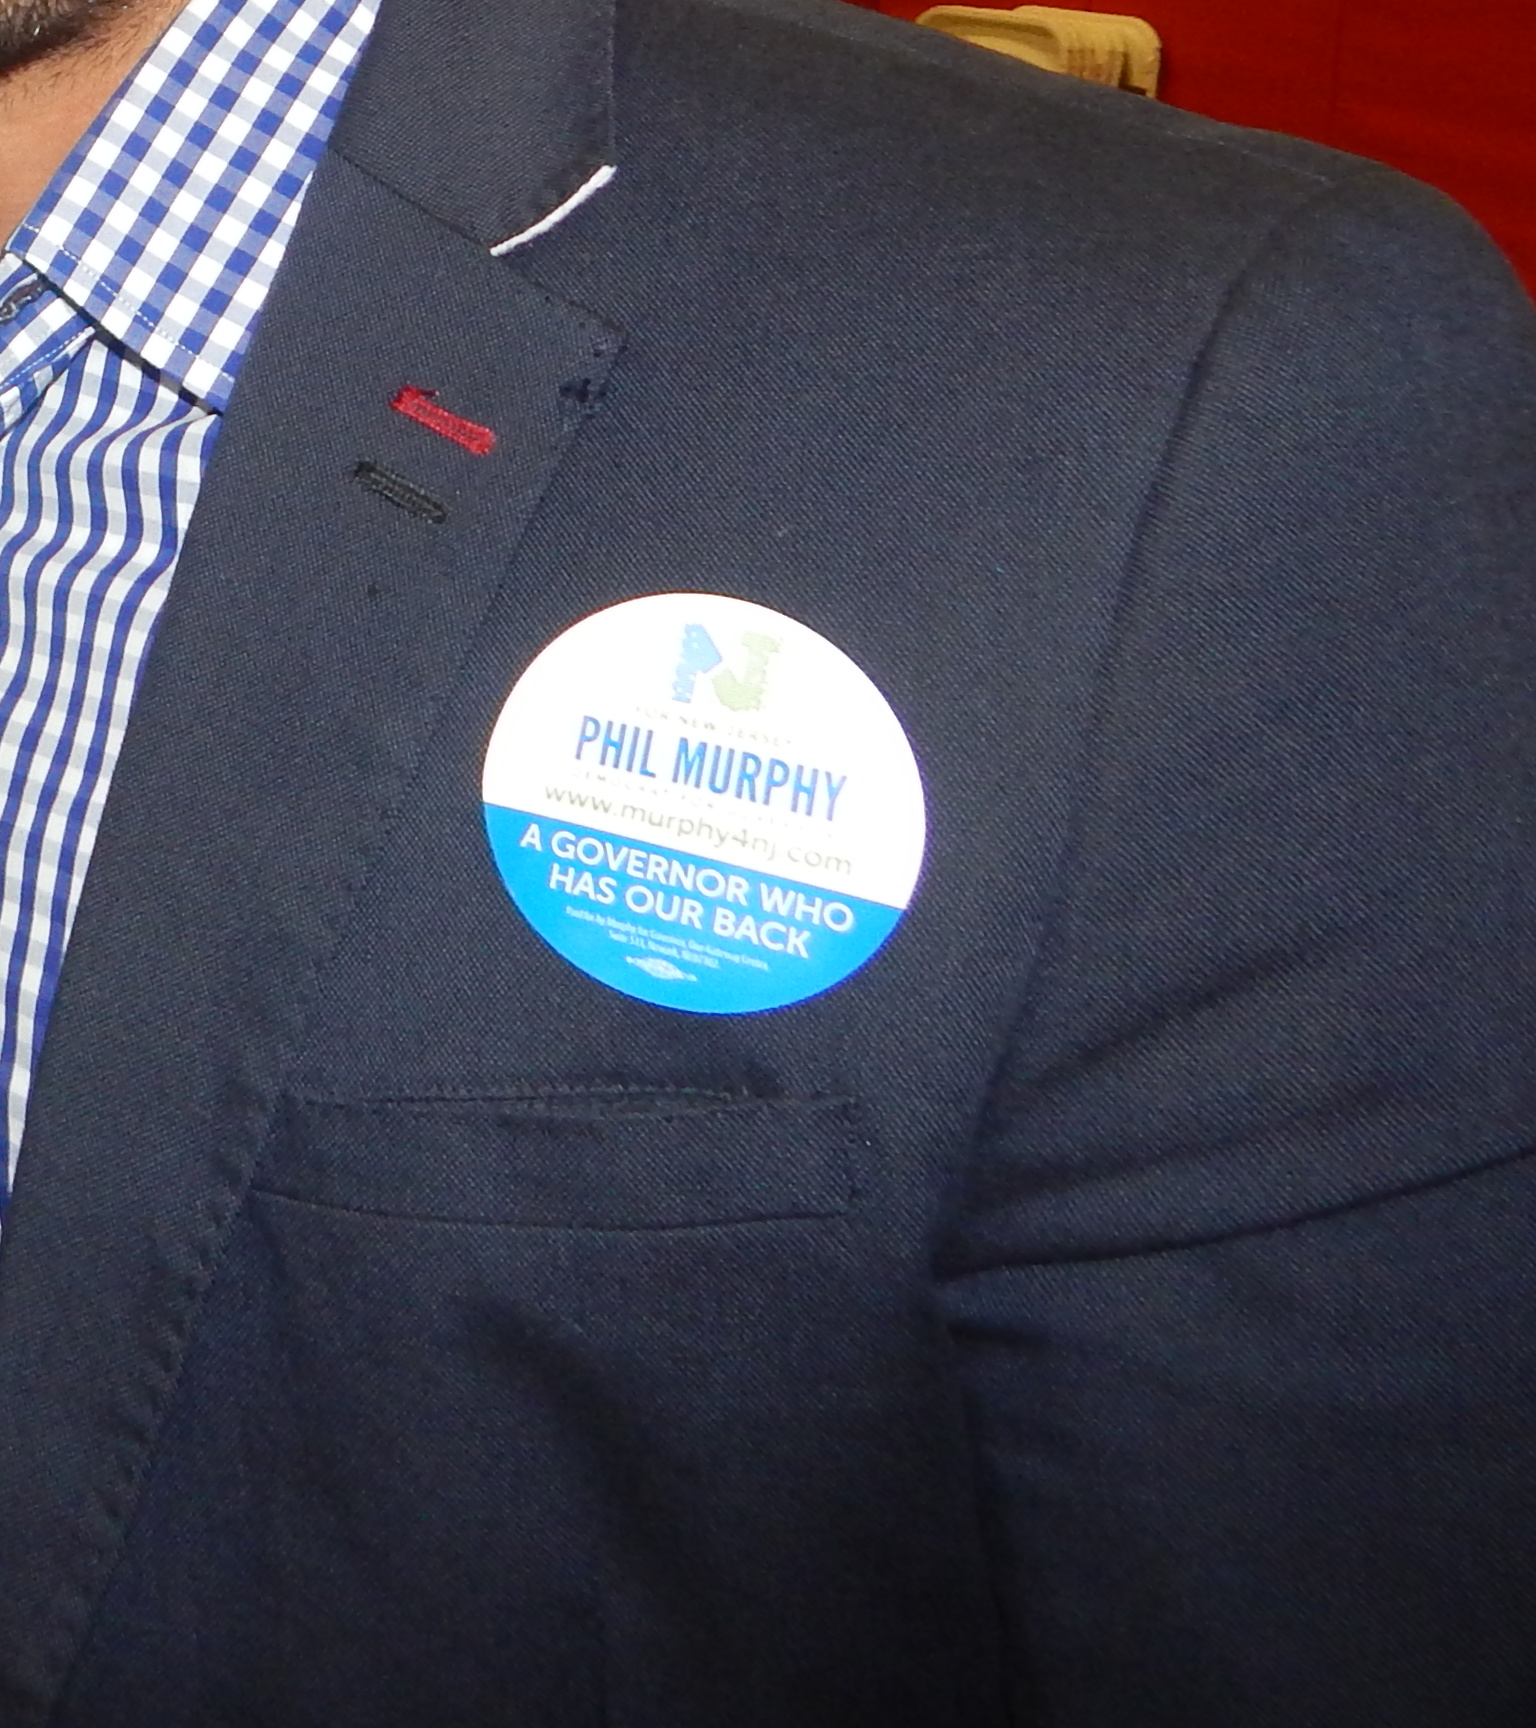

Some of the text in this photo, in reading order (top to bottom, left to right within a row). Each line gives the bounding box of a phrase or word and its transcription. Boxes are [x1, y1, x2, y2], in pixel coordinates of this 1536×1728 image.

[575, 714, 657, 779] PHIL
[671, 736, 847, 822] MURPHY
[519, 822, 855, 933] A GOVERNOR WHO
[544, 785, 853, 876] www.murphy4nj.com
[548, 862, 618, 905] HAS
[624, 884, 705, 930] OUR
[712, 905, 813, 960] BACK
